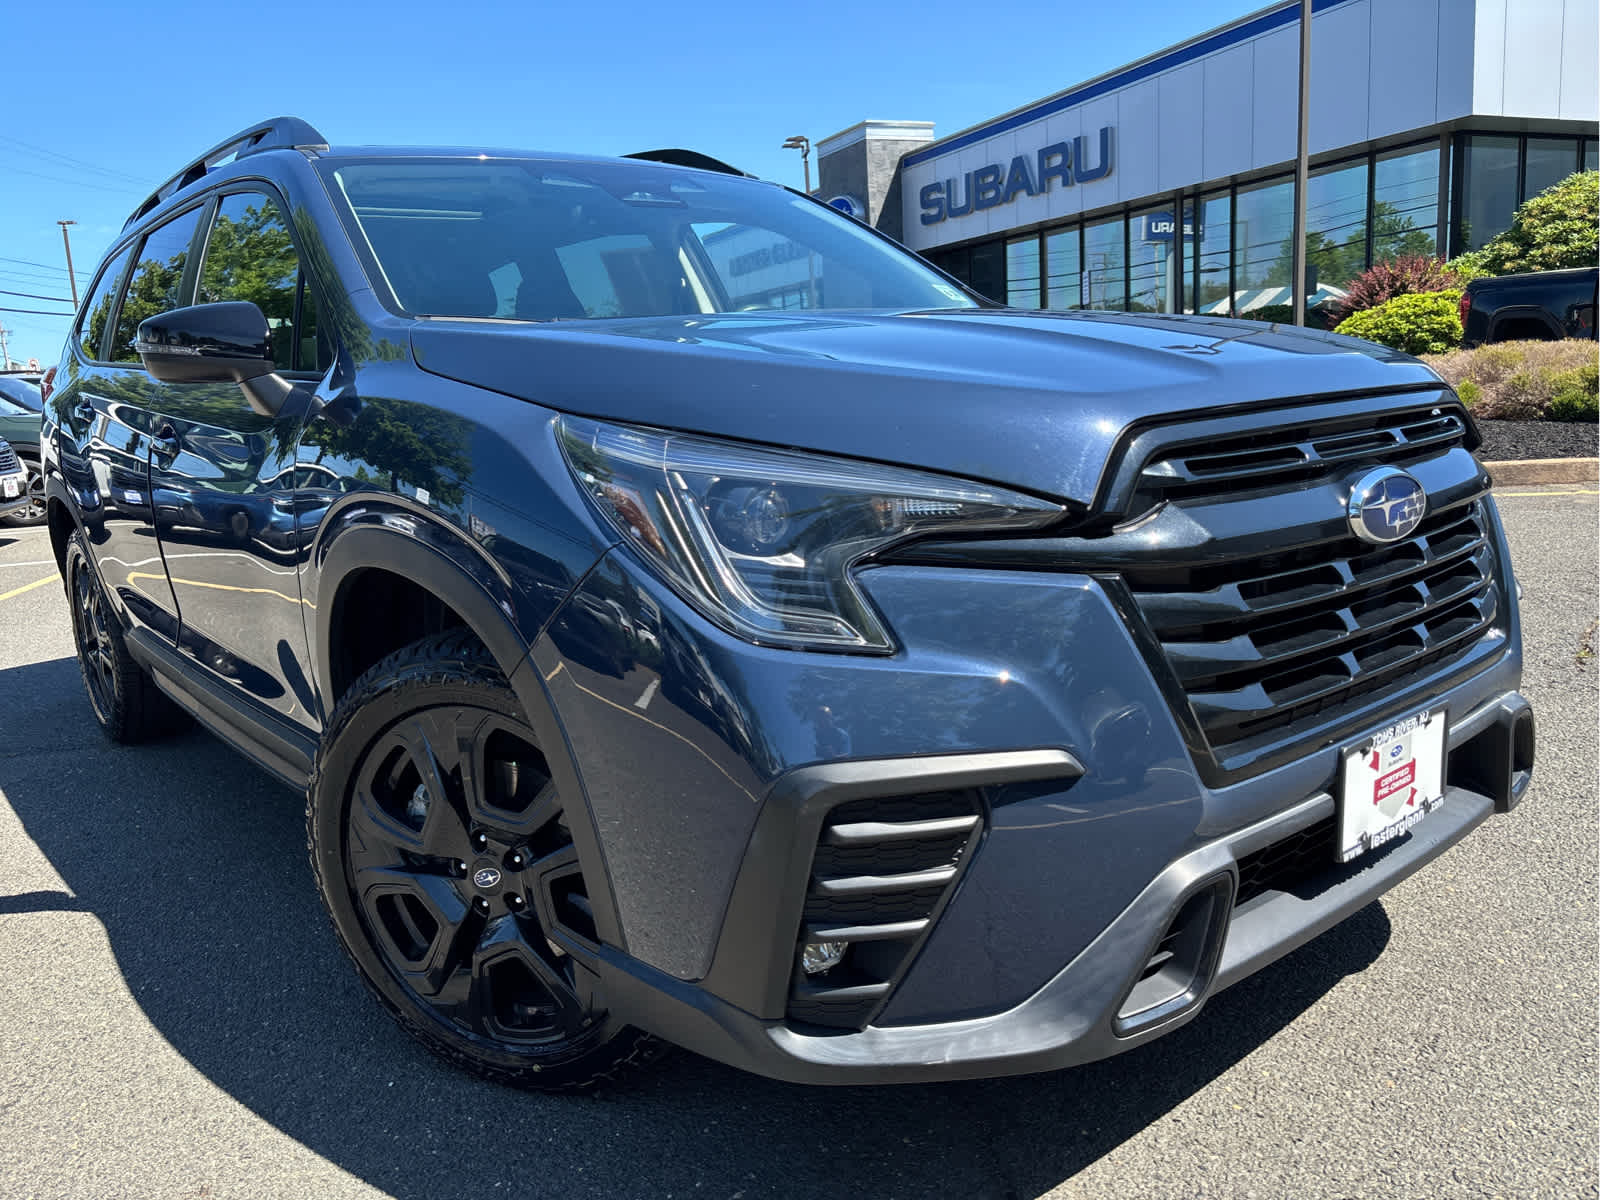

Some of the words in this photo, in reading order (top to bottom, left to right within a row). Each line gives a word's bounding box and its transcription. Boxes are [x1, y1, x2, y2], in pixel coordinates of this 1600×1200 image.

[920, 126, 1113, 226] SUBARU
[1377, 775, 1411, 798] PRE-OWNED
[1380, 767, 1410, 787] CERTIFIED
[1370, 809, 1424, 850] lesterglenn
